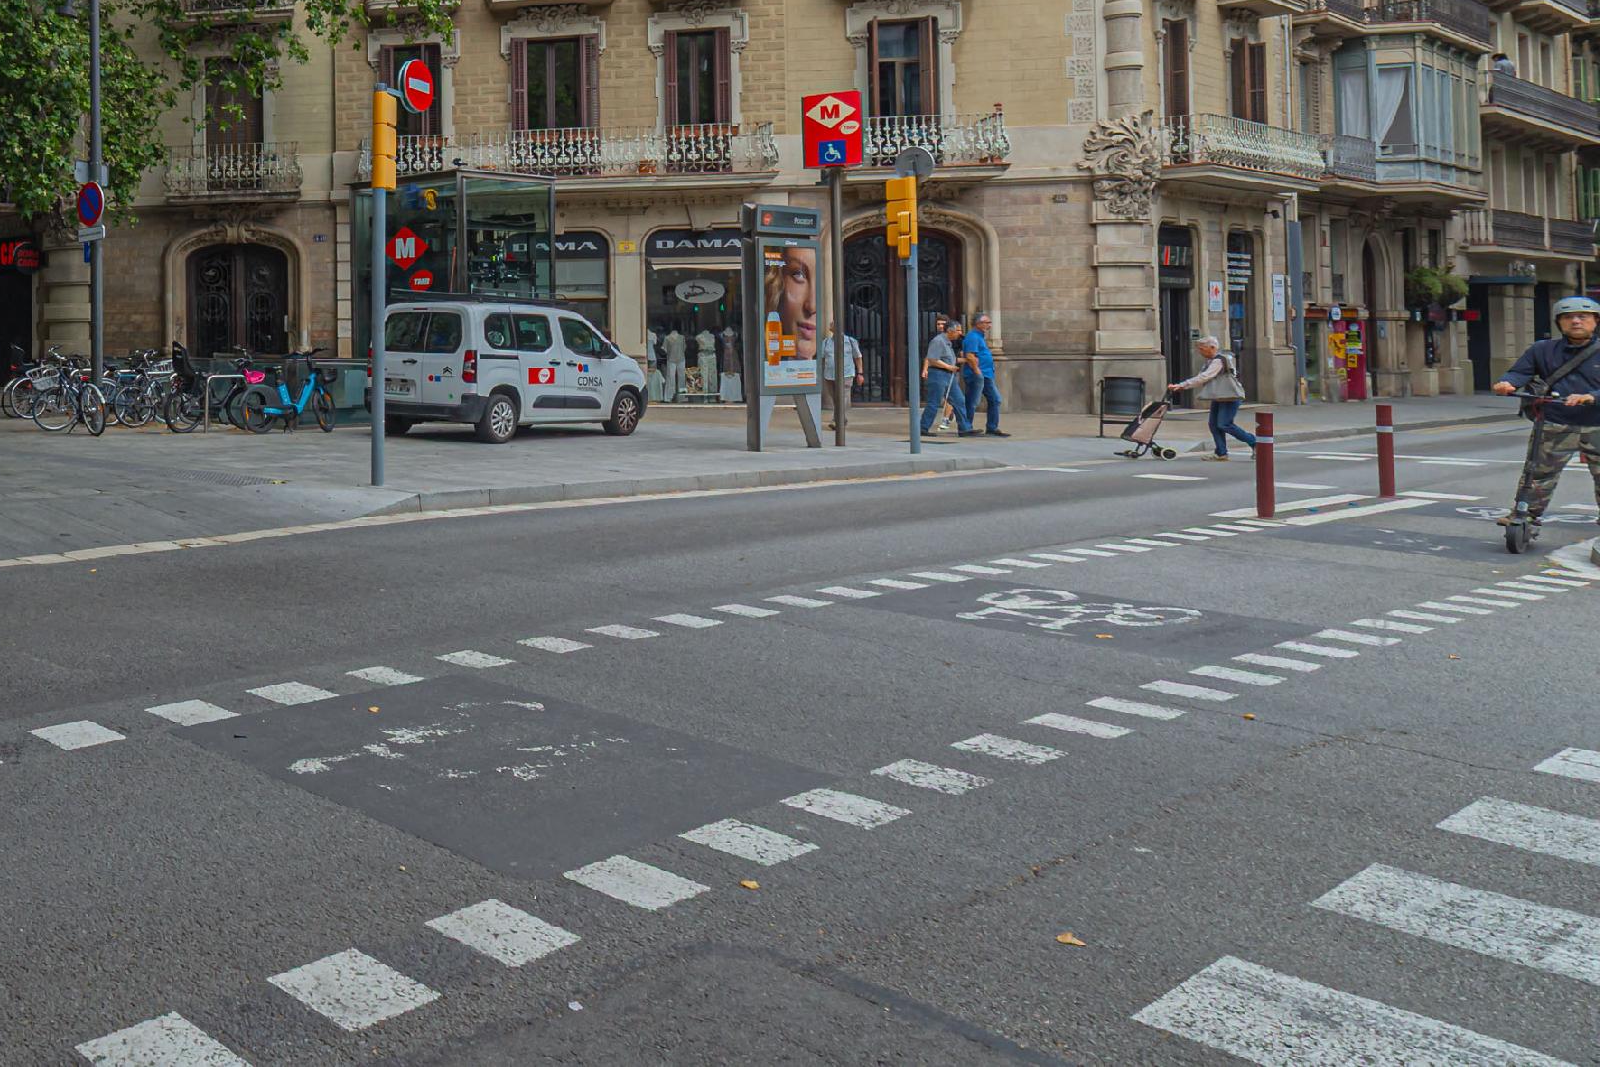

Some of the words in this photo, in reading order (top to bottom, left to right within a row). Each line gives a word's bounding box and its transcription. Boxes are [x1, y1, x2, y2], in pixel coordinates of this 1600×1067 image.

[820, 104, 840, 120] M
[395, 237, 416, 259] M
[655, 238, 742, 249] DAMA
